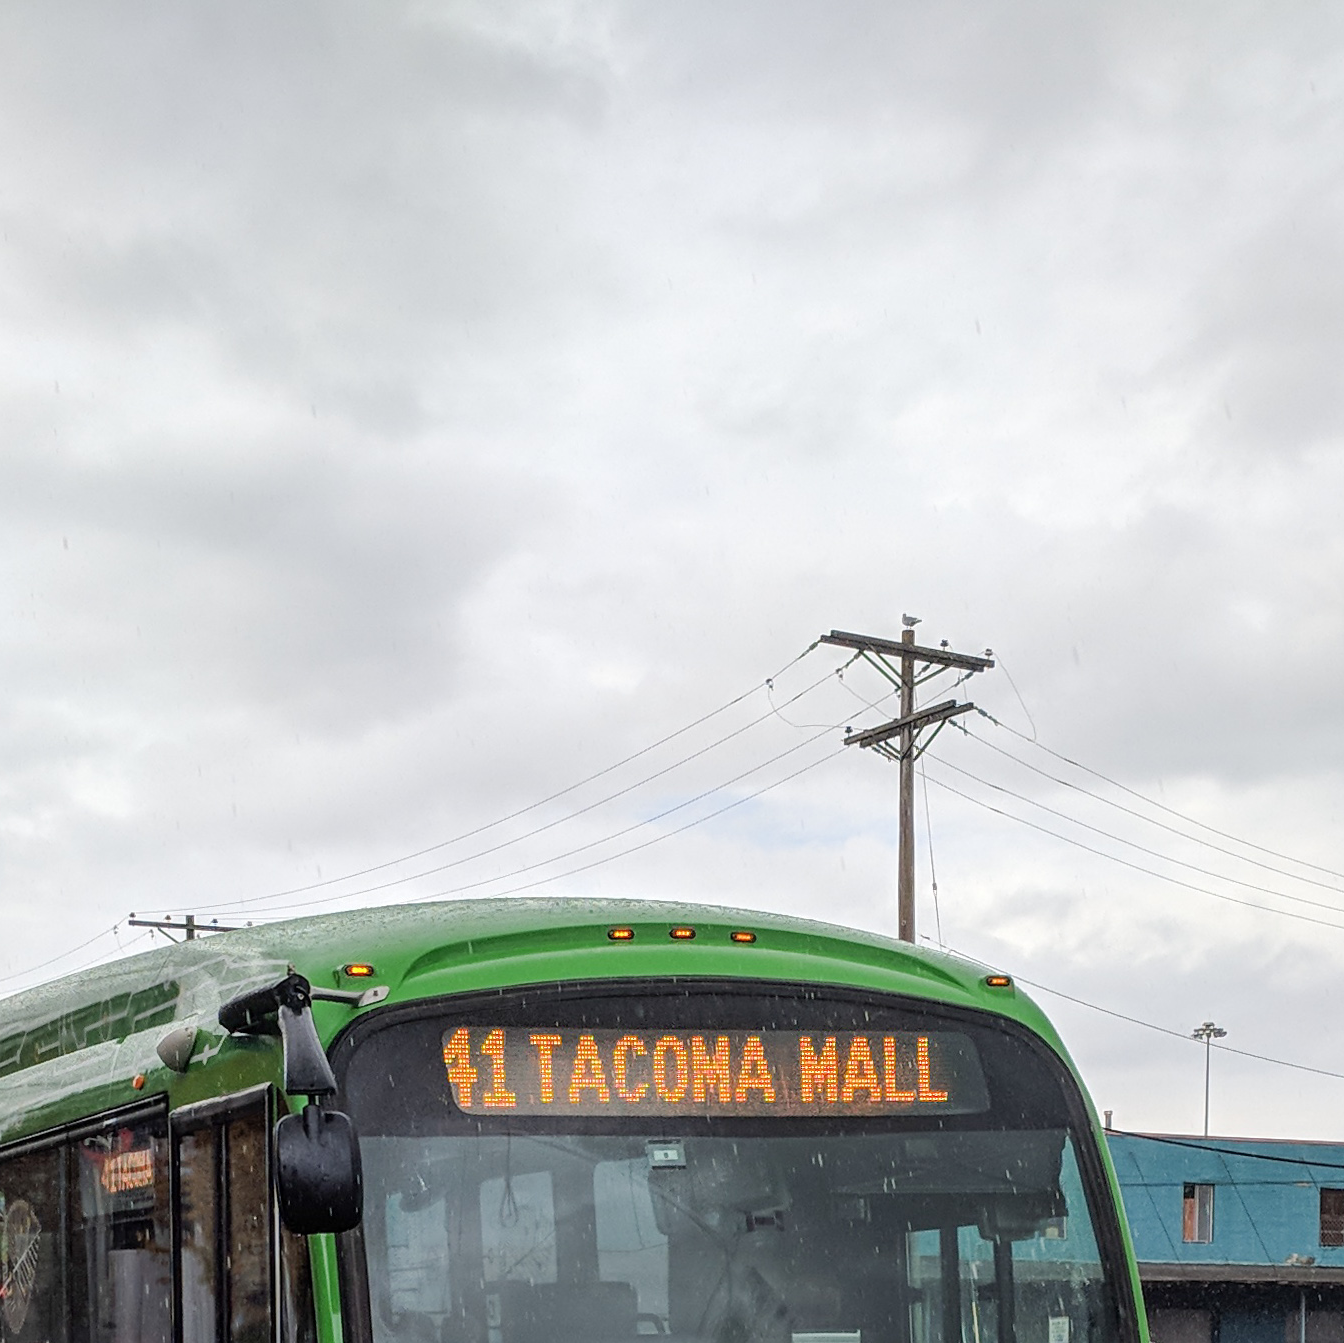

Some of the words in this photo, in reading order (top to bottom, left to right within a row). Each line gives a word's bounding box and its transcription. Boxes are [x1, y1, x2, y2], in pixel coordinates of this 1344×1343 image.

[443, 1028, 517, 1108] 41
[530, 1035, 776, 1103] TACOMA
[799, 1036, 949, 1103] MALL
